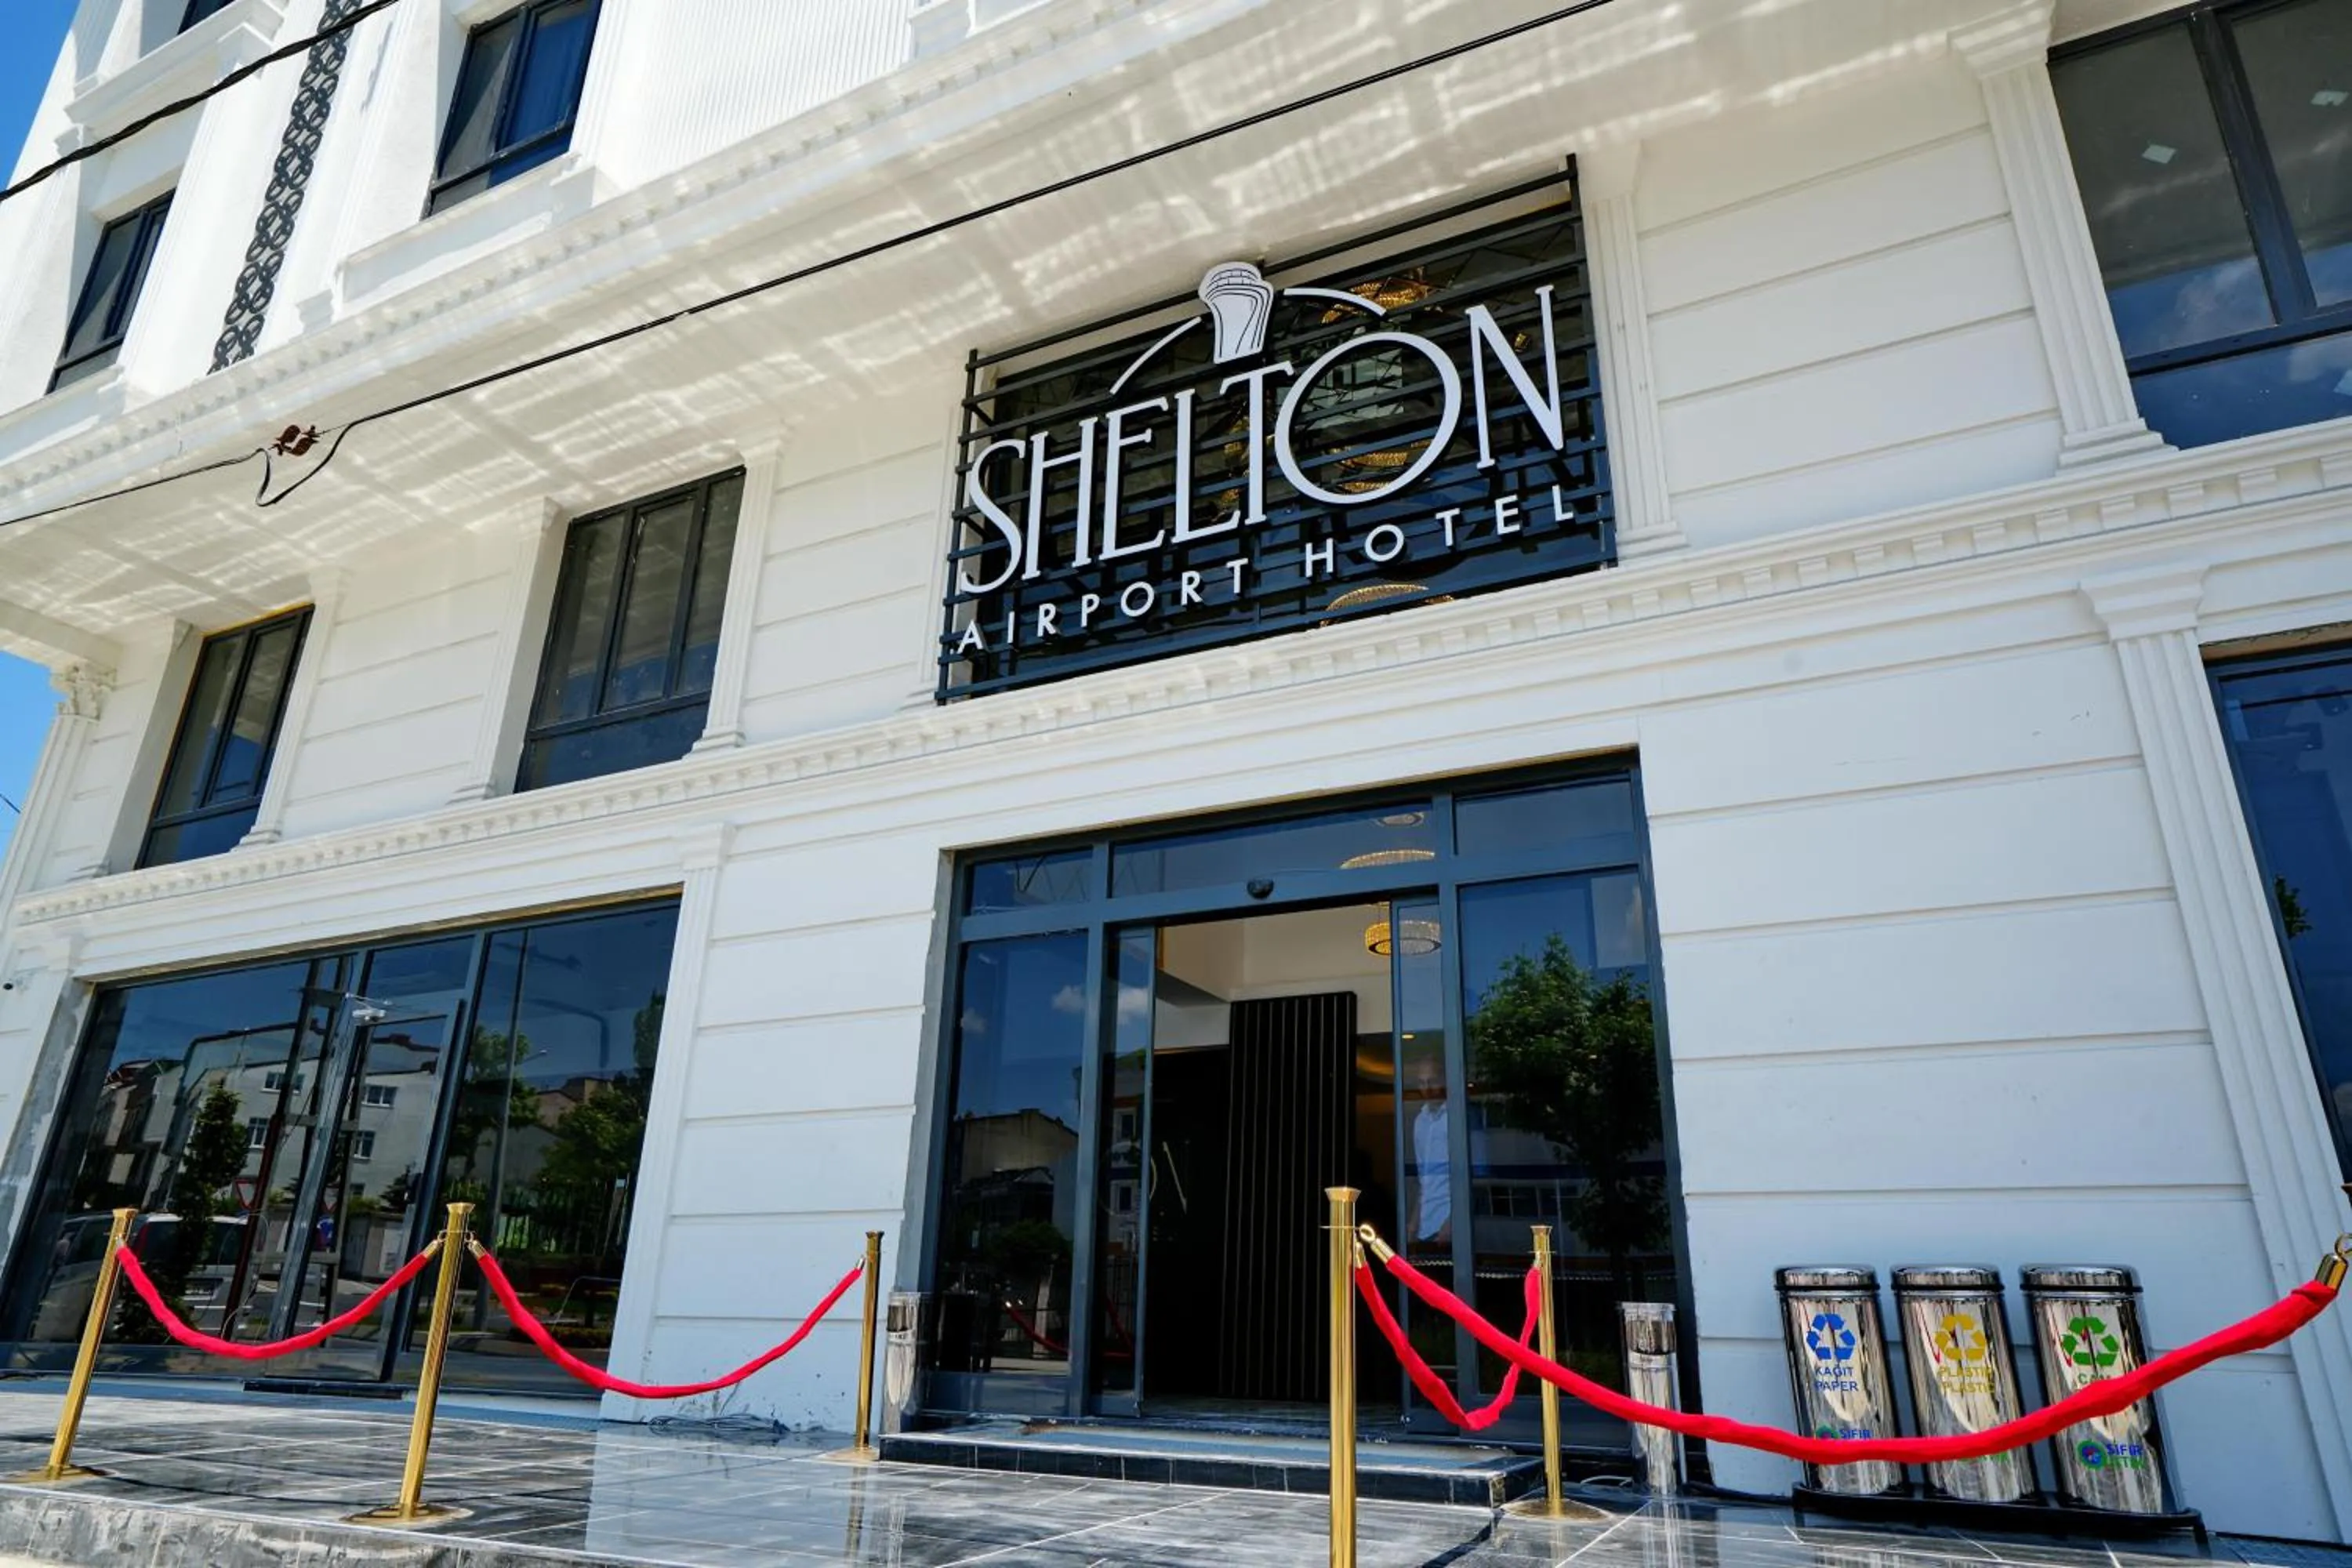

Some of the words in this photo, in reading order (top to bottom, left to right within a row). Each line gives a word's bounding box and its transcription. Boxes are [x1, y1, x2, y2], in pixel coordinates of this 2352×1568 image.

[958, 284, 1563, 595] SHELTON
[957, 558, 1249, 654] AIRPORT
[1305, 484, 1573, 579] HOTEL
[1814, 1381, 1858, 1392] PAPER
